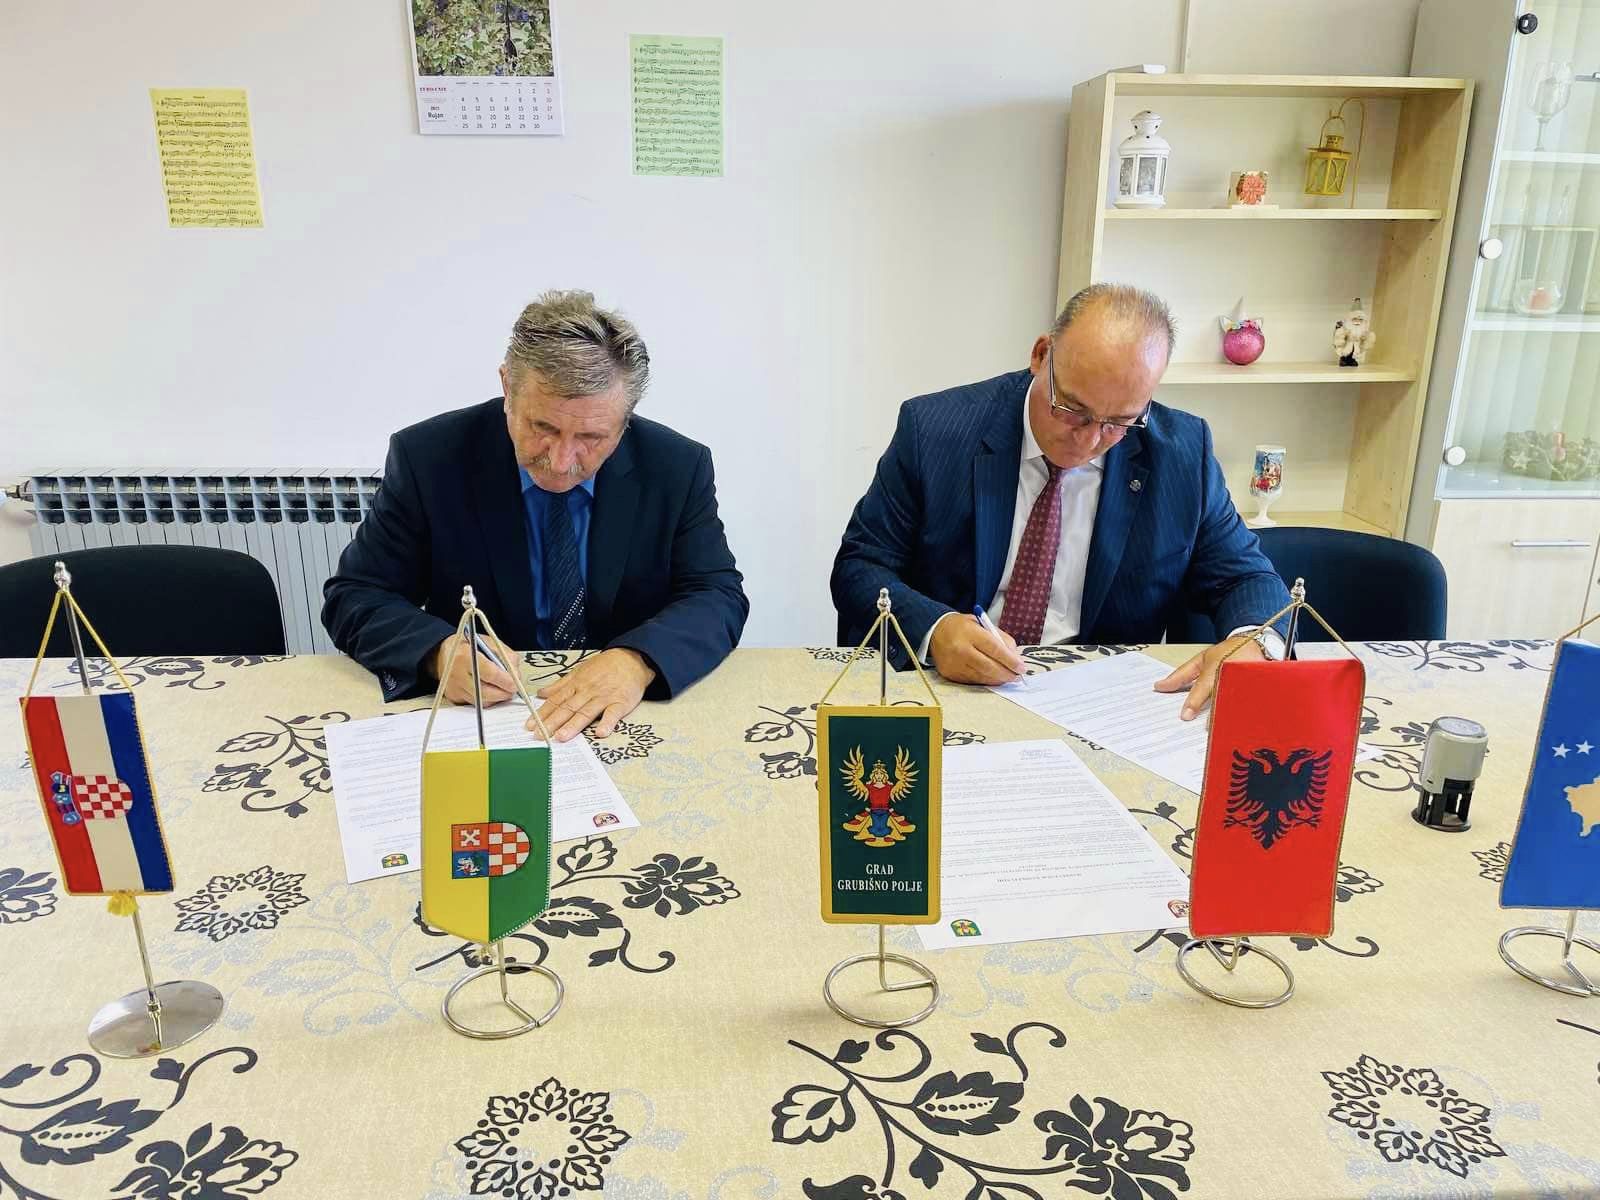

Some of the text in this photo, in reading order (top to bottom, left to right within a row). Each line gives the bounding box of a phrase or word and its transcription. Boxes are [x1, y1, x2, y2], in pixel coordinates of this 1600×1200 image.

[427, 112, 444, 120] Rujan
[865, 863, 894, 875] GRAD
[837, 877, 923, 892] GRUBIŠNO POLJE
